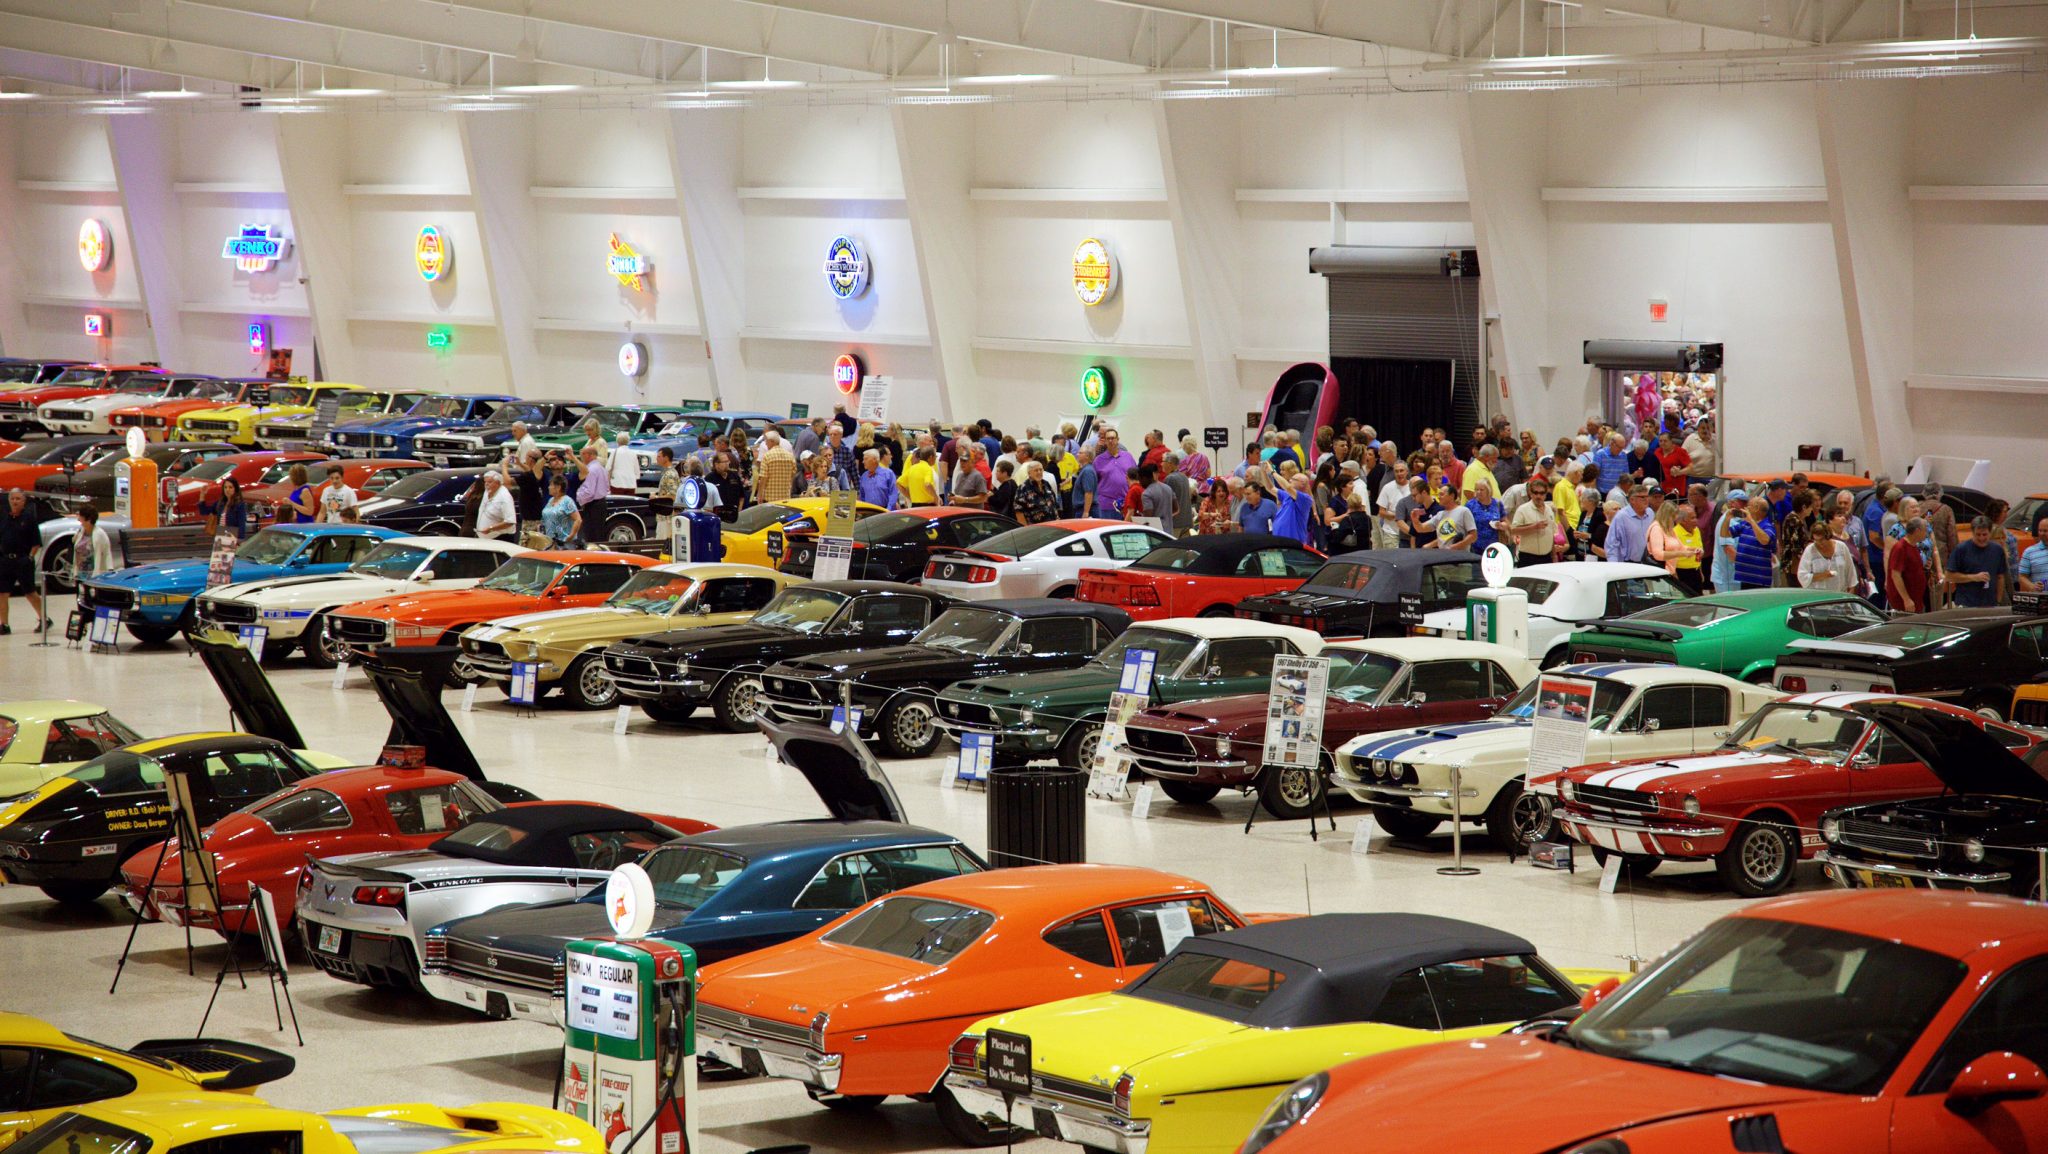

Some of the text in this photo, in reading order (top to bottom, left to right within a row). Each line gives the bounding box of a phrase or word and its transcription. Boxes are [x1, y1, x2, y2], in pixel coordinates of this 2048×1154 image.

[228, 240, 276, 255] YENKO
[1411, 597, 1421, 605] Look
[1412, 612, 1423, 620] Touch
[1287, 659, 1301, 668] Shelby
[1302, 660, 1308, 668] GT
[105, 809, 127, 819] DRIVER:
[128, 807, 140, 816] R.D.
[141, 806, 156, 815] (Bob)
[108, 821, 132, 832] OWNER:
[133, 820, 148, 830] Doug
[99, 845, 115, 853] PURE
[432, 877, 485, 888] YENKO/SC
[487, 957, 498, 966] SS
[599, 963, 633, 985] REGULAR
[991, 1037, 1027, 1055] Please Look
[1003, 1054, 1015, 1067] But
[989, 1066, 1029, 1085] Do Not Touch
[602, 1078, 630, 1092] FIRE-CHIEF
